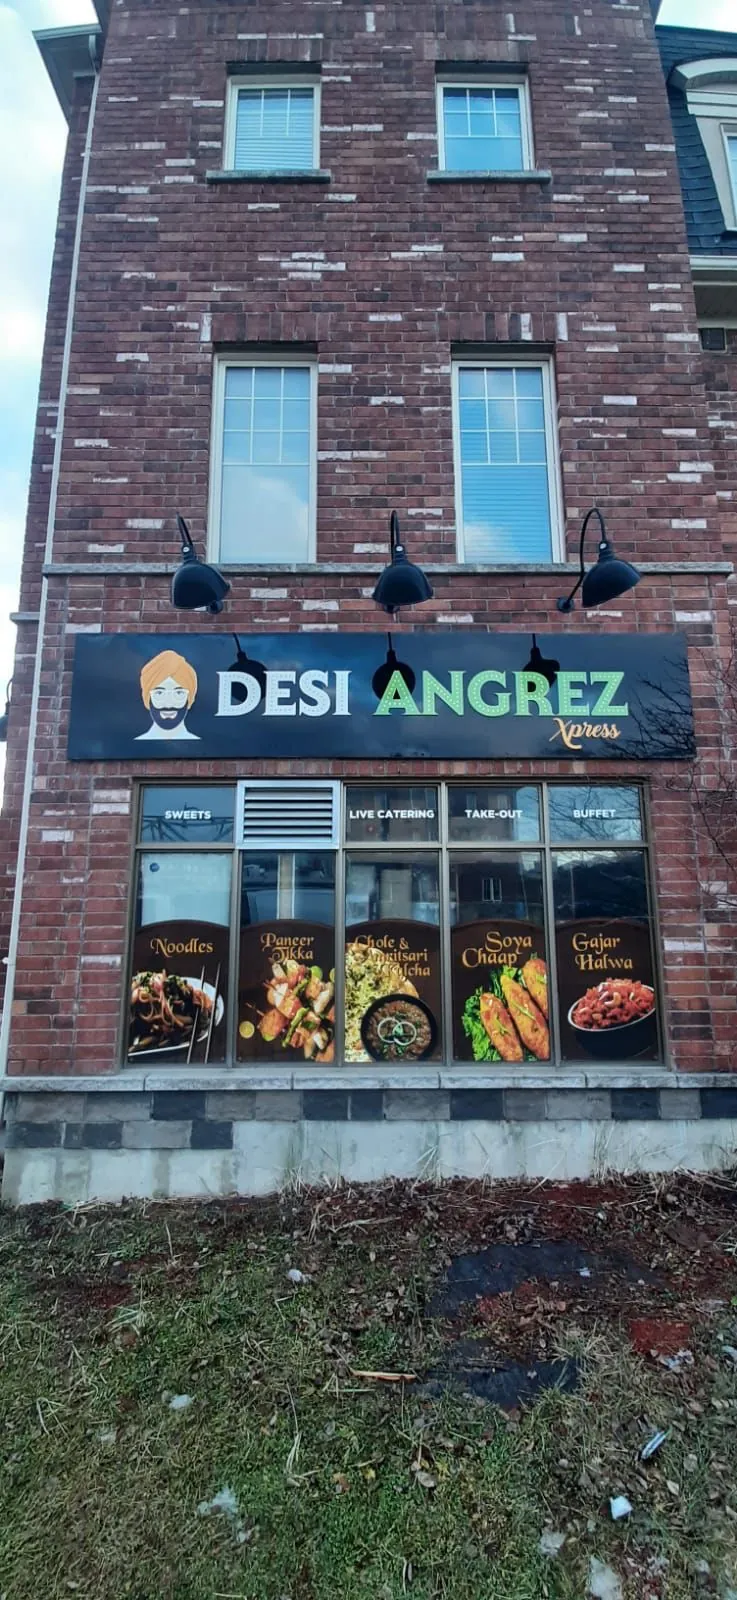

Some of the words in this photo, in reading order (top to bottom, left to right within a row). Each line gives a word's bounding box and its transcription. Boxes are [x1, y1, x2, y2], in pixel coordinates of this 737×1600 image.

[214, 669, 352, 717] DESI
[372, 669, 629, 717] ANGREZ
[549, 717, 621, 750] Xpress
[164, 810, 212, 820] SWEETS
[349, 809, 375, 819] LIVE
[377, 809, 435, 819] CATERING
[464, 809, 523, 819] TAKE-OUT
[573, 809, 616, 819] BUFFET
[150, 937, 214, 958] Noodles
[260, 932, 315, 952] Paneer
[354, 934, 395, 950] Chole
[399, 937, 410, 950] &
[484, 931, 532, 954] Soya
[572, 932, 621, 954] Gajar
[270, 946, 314, 964] Tikka
[371, 948, 429, 962] mritsari
[462, 948, 518, 968] Chaap
[574, 953, 633, 970] Halwa
[386, 962, 431, 977] ulcha
